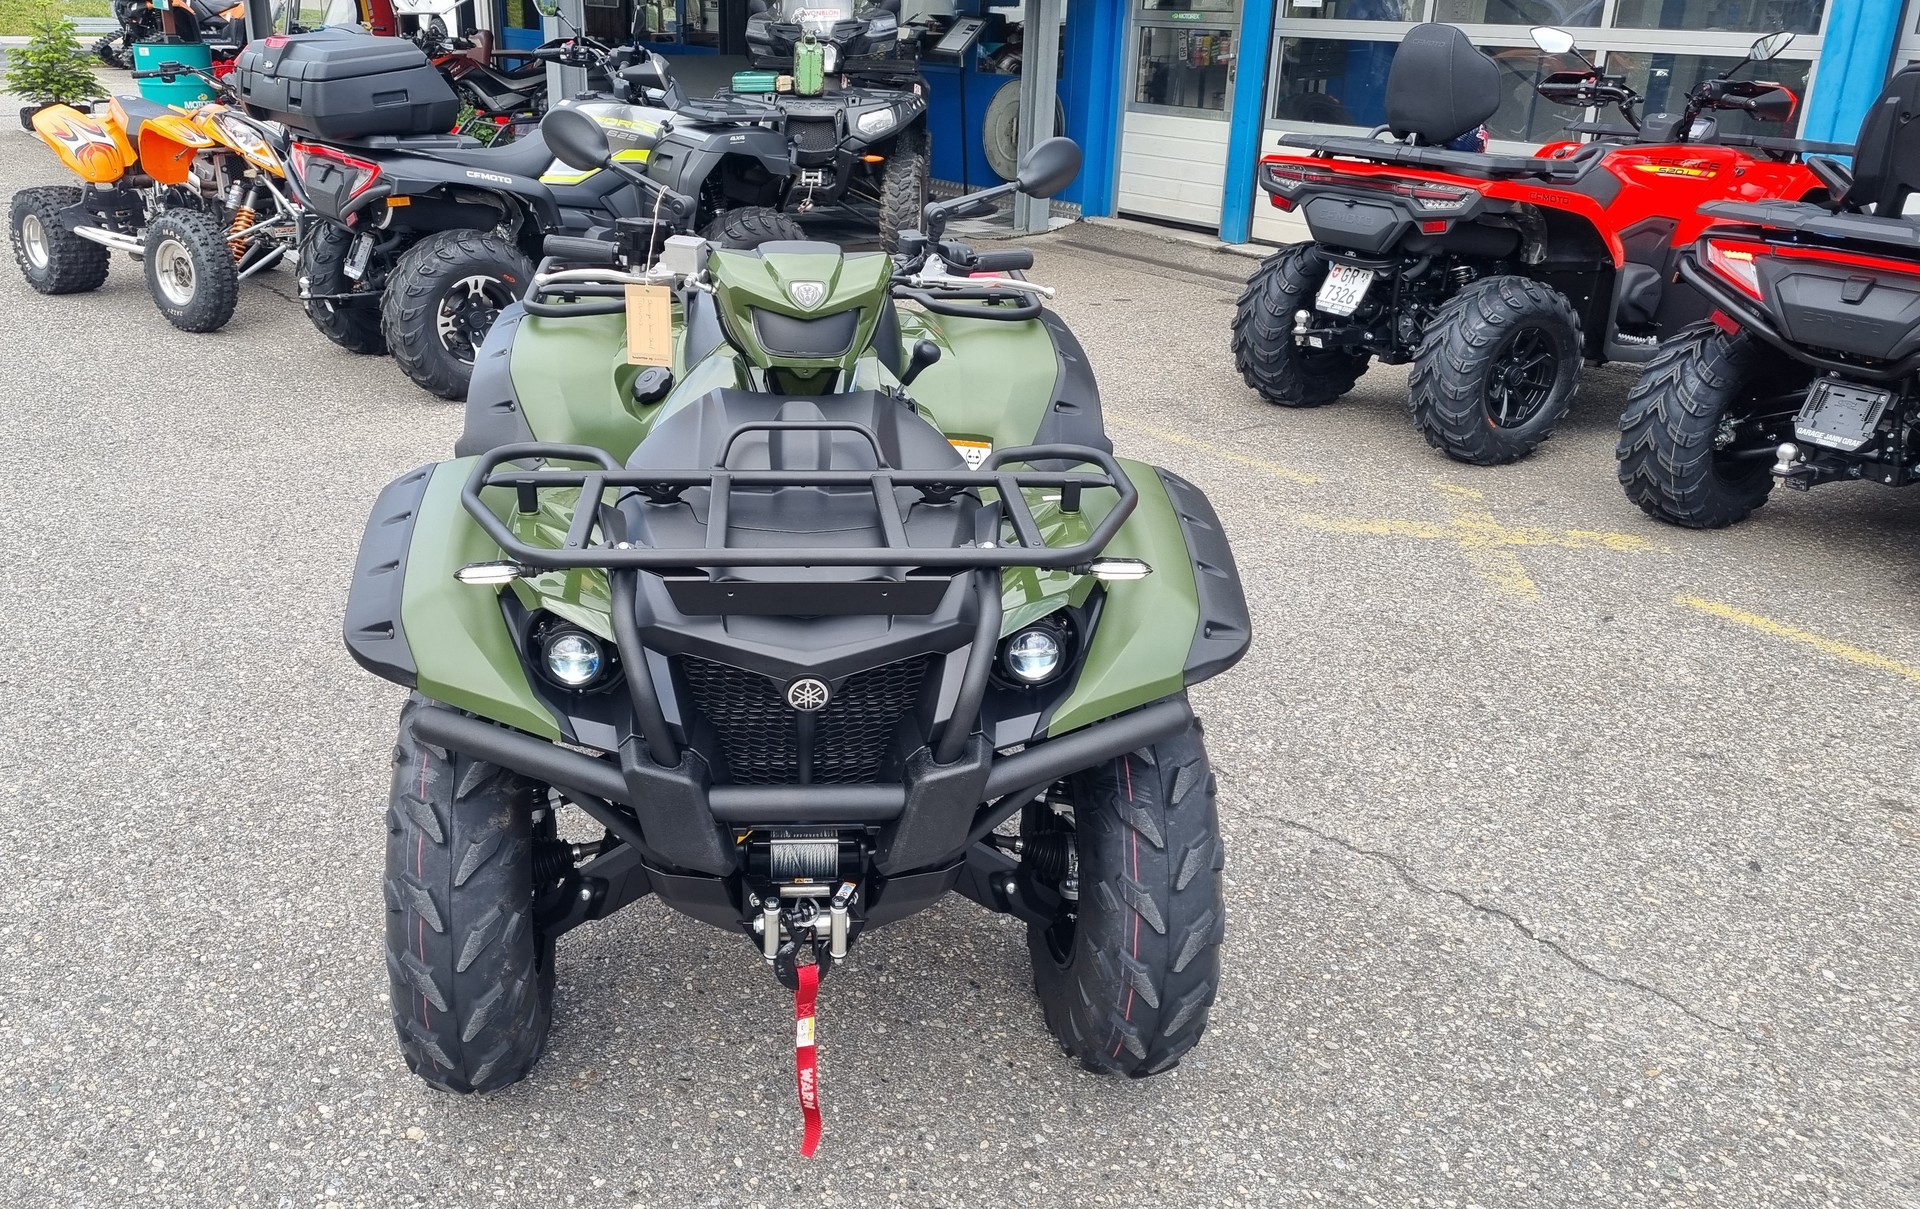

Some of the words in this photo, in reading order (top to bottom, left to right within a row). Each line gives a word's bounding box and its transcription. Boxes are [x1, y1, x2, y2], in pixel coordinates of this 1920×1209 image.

[785, 101, 837, 111] POLARIS
[606, 129, 639, 142] 625
[466, 170, 513, 184] CFMOTO
[1529, 192, 1569, 205] CFMOTO
[1320, 209, 1374, 227] CFMOTO
[14, 230, 32, 271] MAXXIS
[1340, 267, 1360, 285] GR
[1325, 284, 1357, 305] 7326
[1796, 427, 1825, 439] GARAGE
[1824, 433, 1842, 443] JANN
[1842, 437, 1862, 447] GRAF
[800, 1067, 816, 1110] WARN
